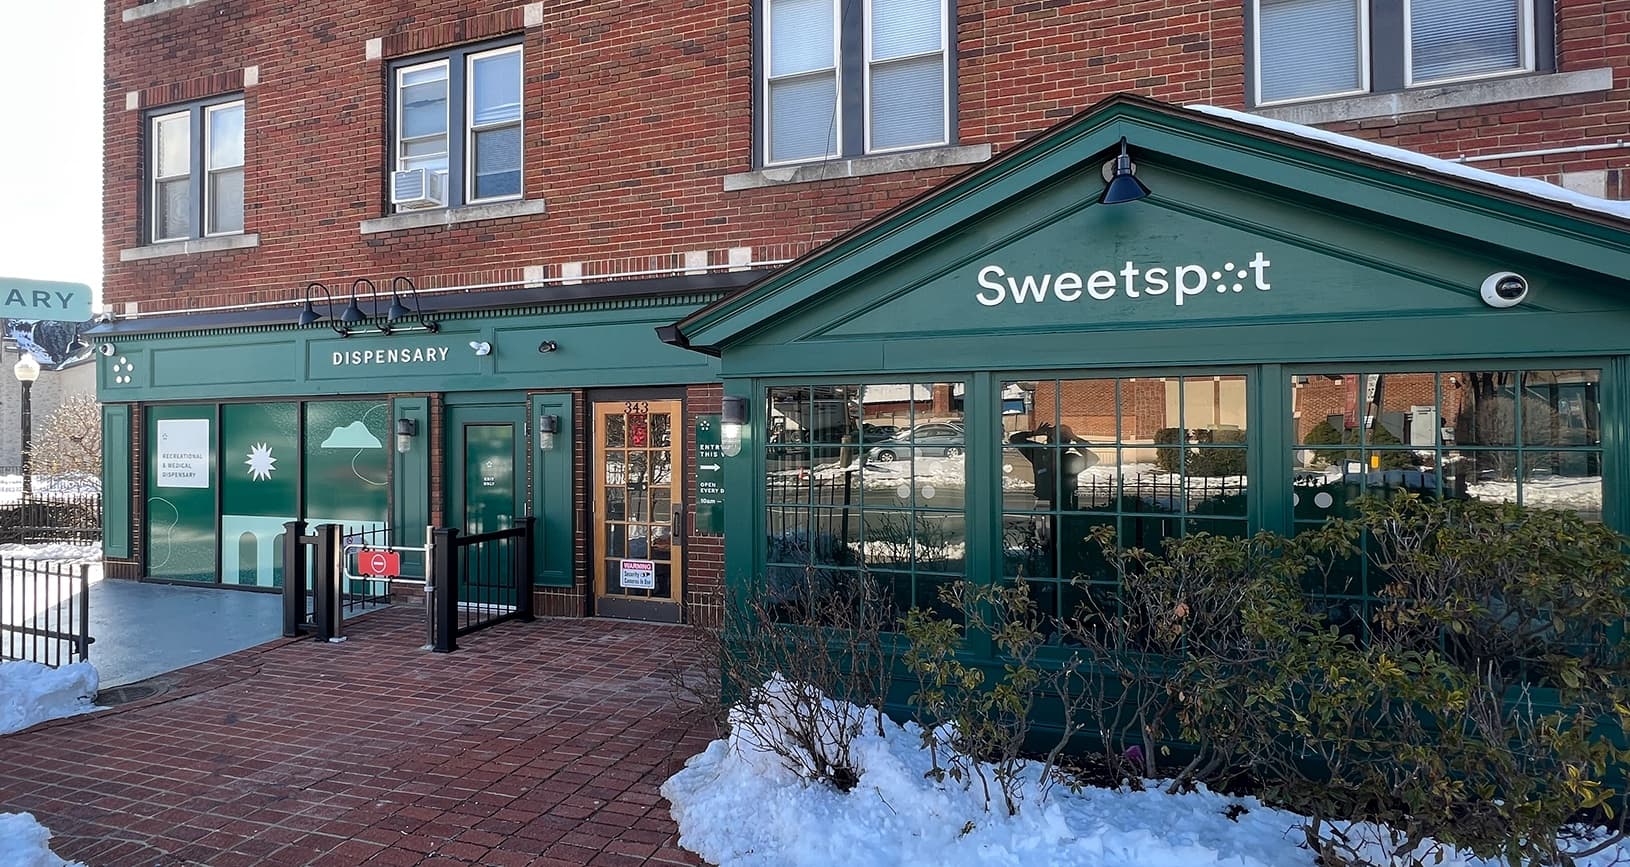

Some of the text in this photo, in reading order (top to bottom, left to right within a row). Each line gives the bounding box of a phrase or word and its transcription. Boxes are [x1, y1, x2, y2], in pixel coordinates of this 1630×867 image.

[4, 288, 75, 309] ARY
[332, 346, 449, 366] DISPENSARY
[624, 400, 649, 415] 343
[623, 562, 651, 570] WARNING
